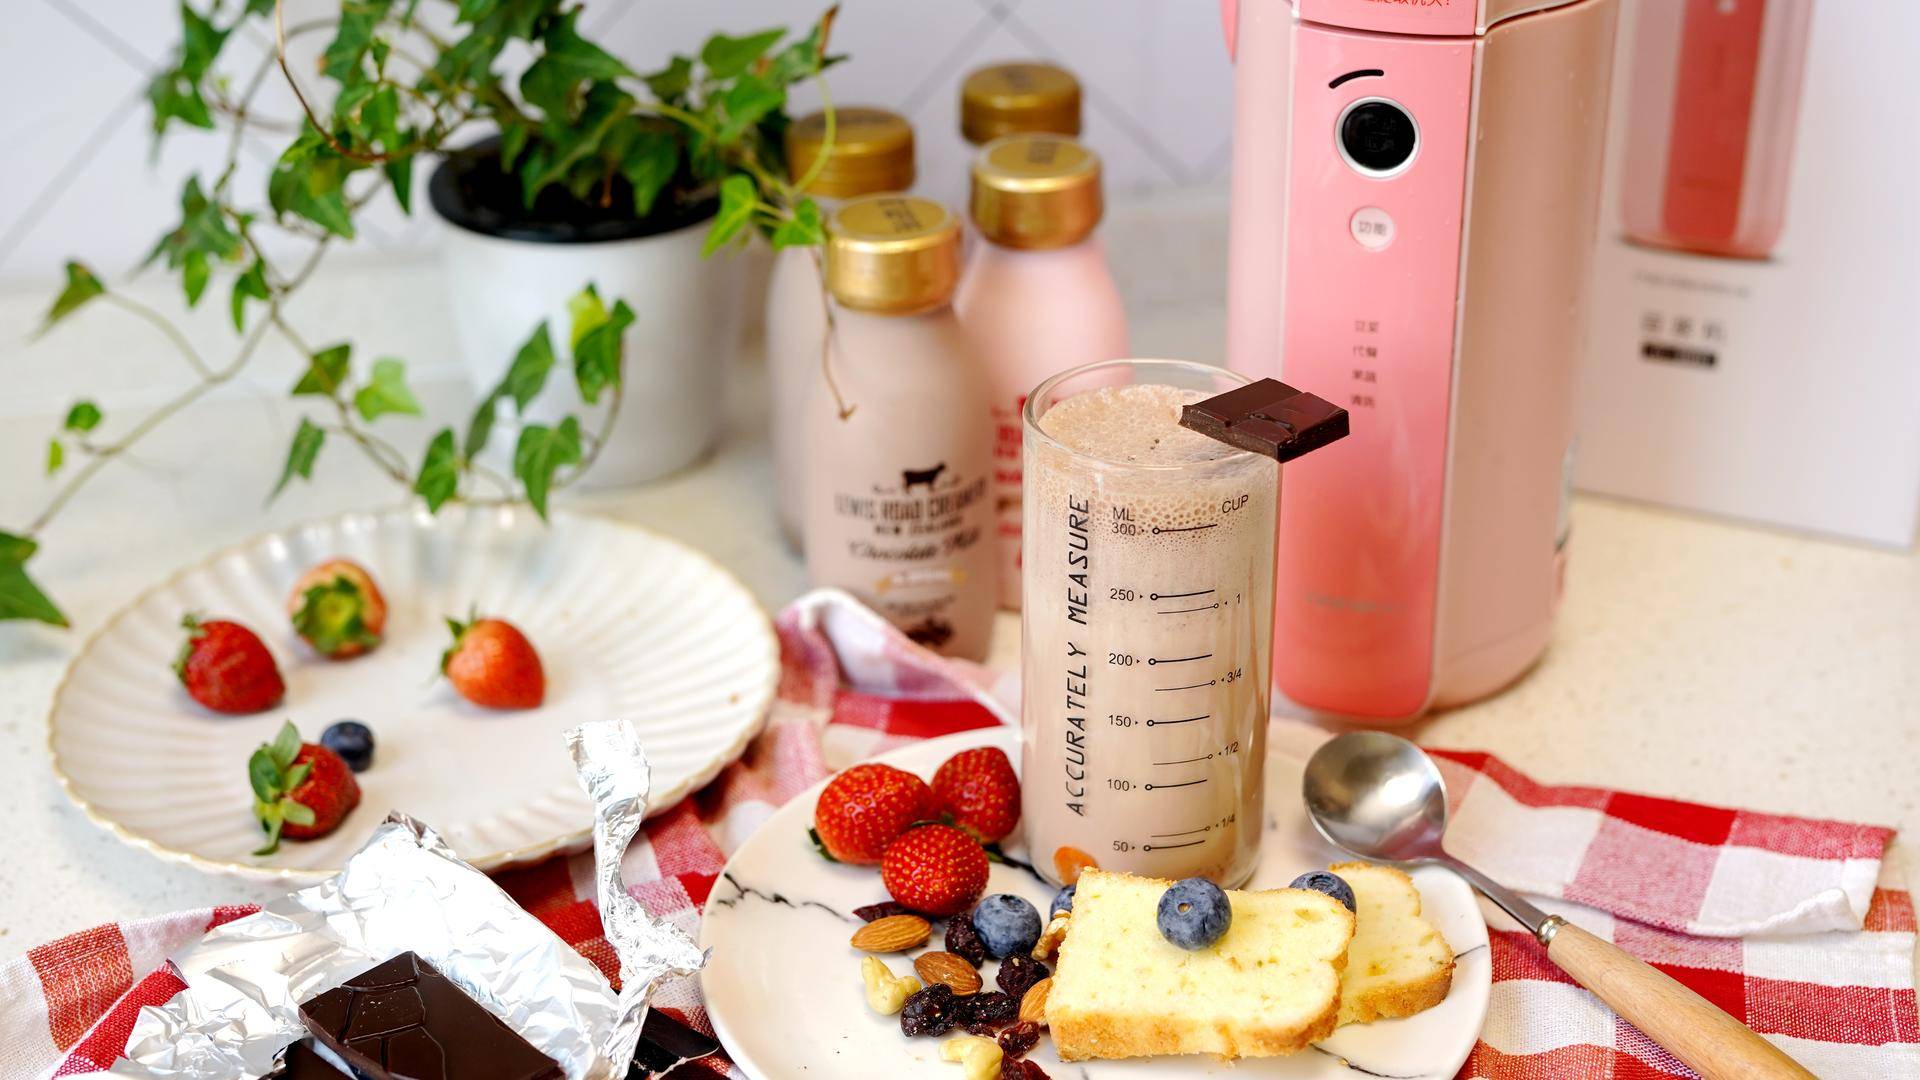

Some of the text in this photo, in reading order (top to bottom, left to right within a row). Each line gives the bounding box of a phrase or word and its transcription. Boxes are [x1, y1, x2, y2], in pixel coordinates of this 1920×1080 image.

[1358, 220, 1387, 236] 功能
[881, 499, 921, 521] ROAD
[1221, 494, 1249, 514] CUP
[1112, 507, 1135, 522] ML
[1111, 522, 1136, 536] 300
[1109, 588, 1134, 602] 250
[1236, 593, 1241, 604] 1
[1066, 494, 1089, 816] ACCURATELY MEASURE
[1108, 653, 1133, 666] 200
[1227, 668, 1242, 683] 3/4
[1108, 714, 1132, 728] 150
[1224, 742, 1239, 756] 1/2
[1107, 779, 1130, 791] 100
[1222, 814, 1236, 828] 1/4
[1113, 840, 1128, 853] 50
